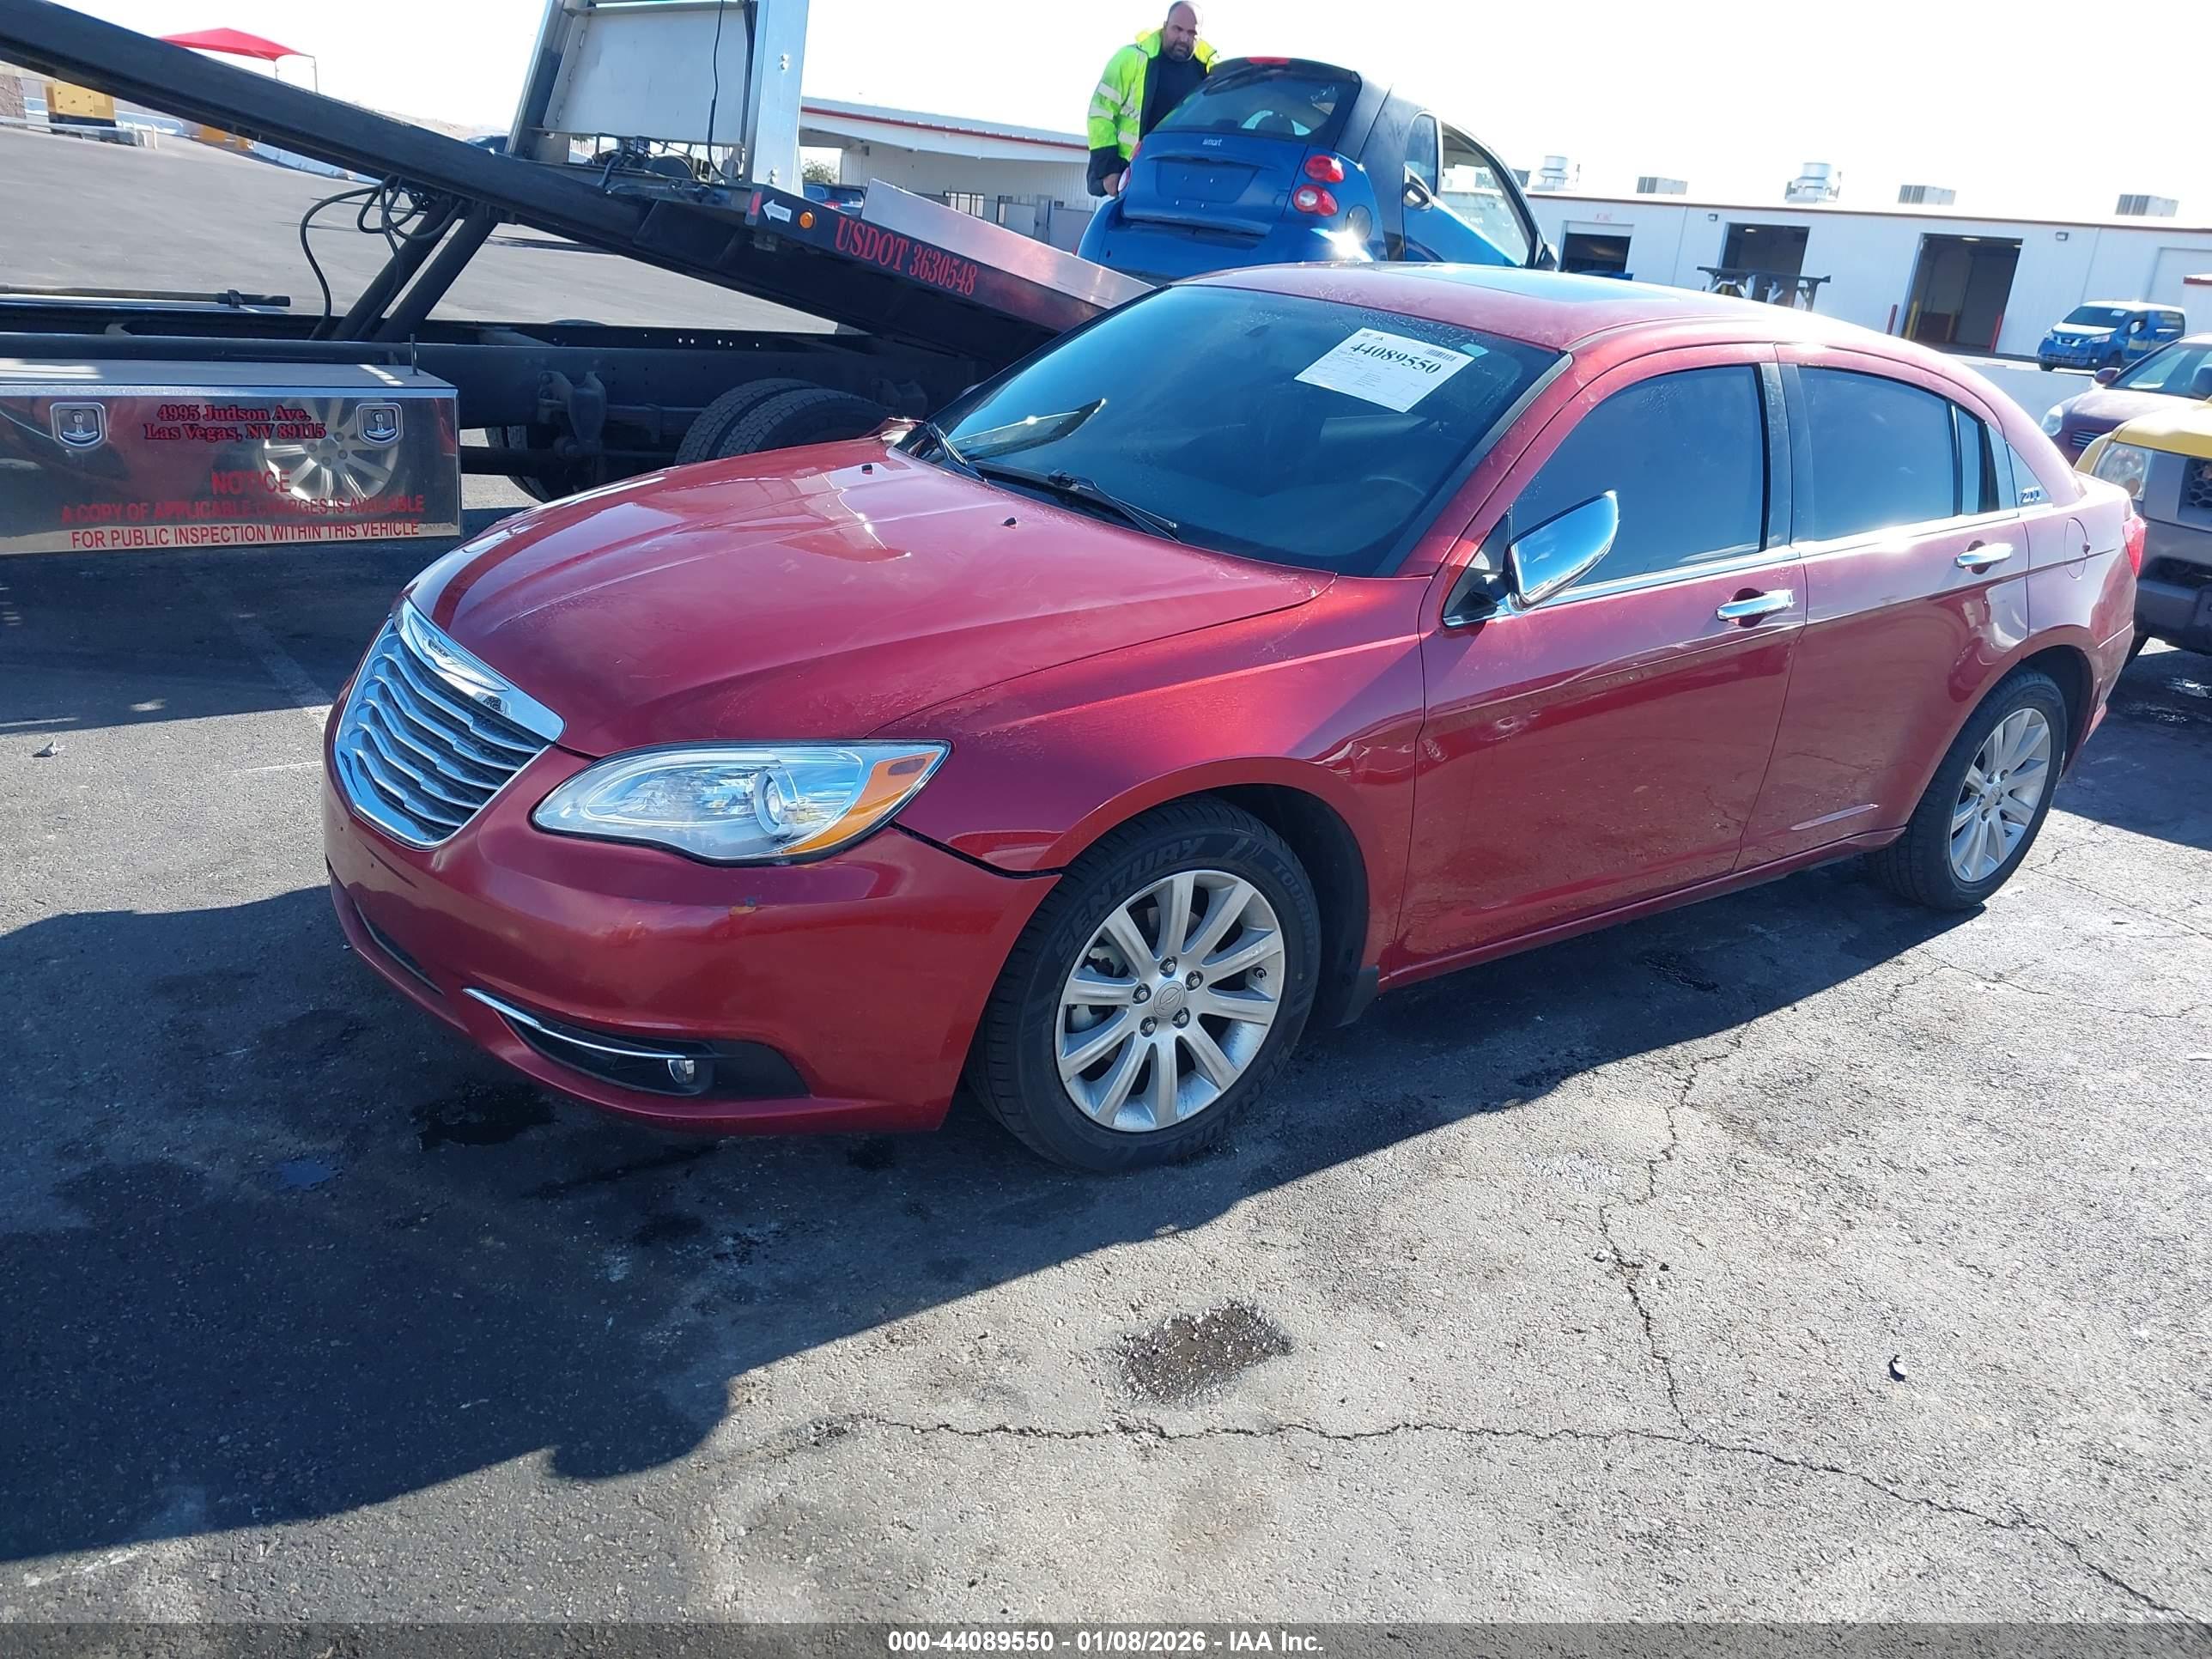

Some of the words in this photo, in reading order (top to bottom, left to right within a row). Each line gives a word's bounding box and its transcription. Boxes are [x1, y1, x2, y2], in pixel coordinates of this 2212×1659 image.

[836, 216, 908, 270] USDOT
[909, 245, 977, 295] 3630548
[1351, 343, 1442, 374] 44089550
[157, 404, 199, 421] 4995
[204, 404, 270, 422] Judson
[272, 404, 312, 422] Ave.
[144, 423, 180, 441] Las
[182, 423, 243, 442] Vegas,
[245, 423, 274, 441] NV
[276, 423, 326, 441] 89115
[211, 470, 291, 495] NOTICE
[76, 503, 123, 523] COPY
[125, 502, 149, 522] OF
[154, 501, 249, 521] APPLICABLE
[333, 498, 344, 514] IS
[71, 530, 106, 549] FOR
[111, 527, 169, 547] PUBLIC
[174, 524, 266, 545] INSPECTION
[270, 523, 322, 542] WITHIN
[327, 522, 357, 539] THIS
[362, 519, 420, 537] VEHICLE
[1056, 836, 1208, 957] SENTURY
[1271, 860, 1316, 955] TOURING
